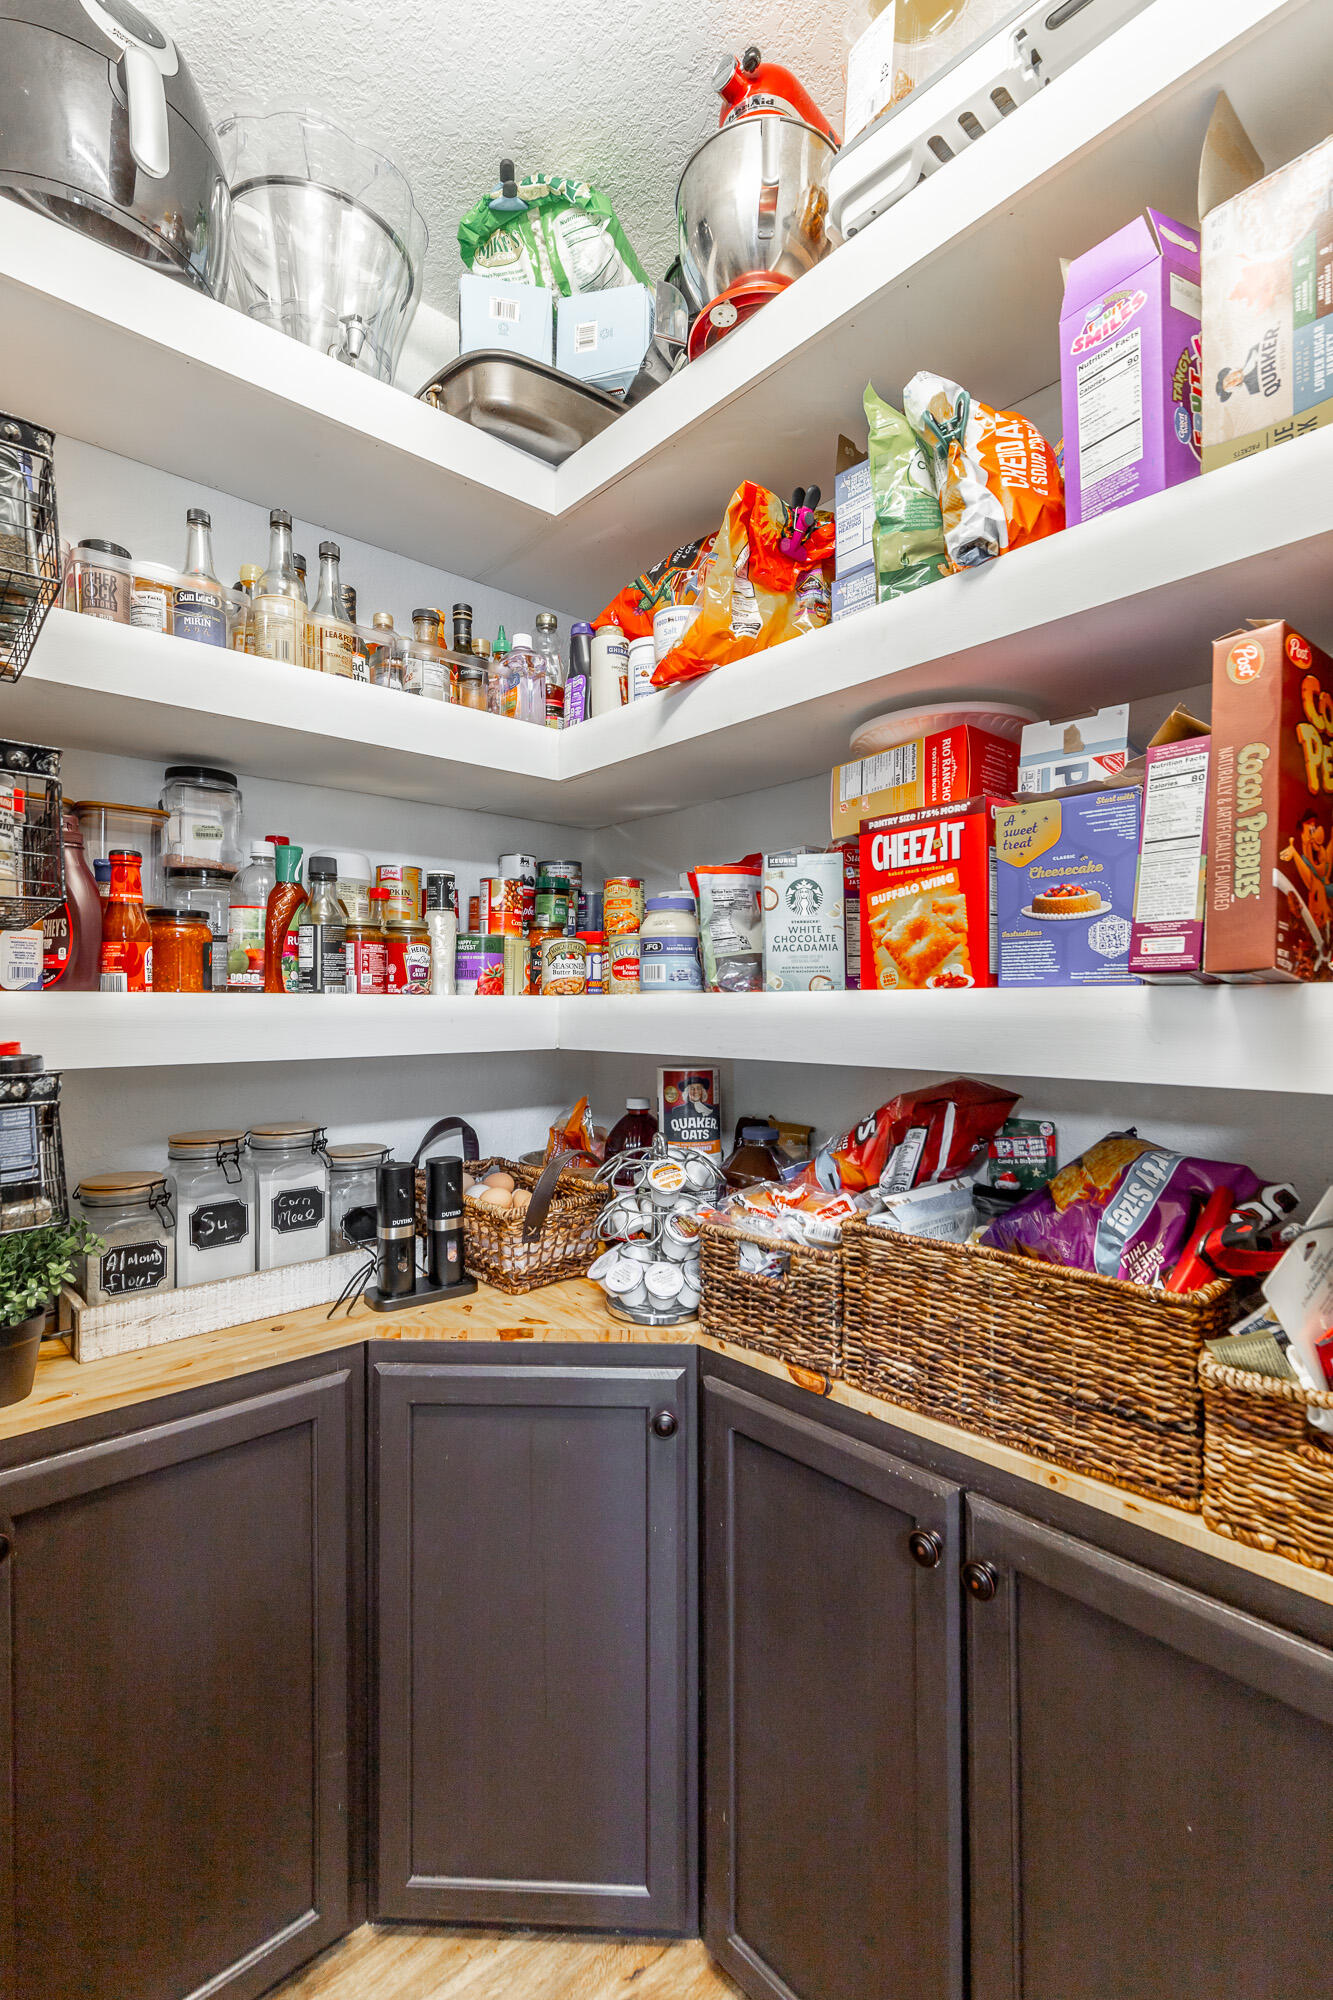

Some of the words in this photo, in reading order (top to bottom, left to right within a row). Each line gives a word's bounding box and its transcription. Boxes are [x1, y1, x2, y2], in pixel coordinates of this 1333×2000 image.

[560, 213, 586, 225] Nutrition
[1072, 292, 1146, 353] SMILES
[1313, 324, 1326, 357] SUGAR
[1078, 347, 1113, 372] Nutrition
[1115, 331, 1139, 349] Facts
[1262, 328, 1280, 397] QUAKER
[1079, 376, 1106, 395] Calories
[1127, 354, 1139, 367] 90
[1172, 348, 1192, 402] TANGY
[1313, 358, 1326, 393] LOWER
[1030, 452, 1048, 485] SOUR
[838, 520, 862, 535] HEATING
[179, 591, 195, 603] Sun
[195, 592, 216, 606] Luck
[183, 616, 211, 628] MIRIN
[663, 626, 677, 636] Salt
[325, 629, 338, 640] LEA
[608, 647, 629, 655] GHIRA
[1290, 638, 1309, 661] Post
[1233, 645, 1258, 677] Post
[941, 737, 952, 756] RIO
[1150, 759, 1183, 770] Nutrition
[1185, 755, 1206, 763] Facts
[1216, 747, 1233, 795] NATURALLY
[941, 758, 952, 802] RANCHO
[1149, 780, 1178, 790] Calories
[1191, 773, 1205, 782] 80
[1235, 742, 1271, 814] COCOA
[1095, 795, 1116, 805] Start
[1116, 792, 1135, 802] with
[1216, 797, 1230, 805] &
[868, 816, 899, 830] PANTRY
[898, 812, 916, 824] SIZE
[921, 808, 939, 819] 75%
[1003, 814, 1016, 827] A
[1003, 822, 1039, 838] sweet
[1215, 806, 1232, 862] ARTIFICIALLY
[1003, 836, 1032, 850] treat
[1233, 812, 1268, 900] PEBBLES
[920, 864, 944, 872] crackers
[1028, 861, 1104, 880] Cheesecake
[389, 888, 411, 896] PKIN
[871, 882, 920, 906] BUFFALO
[920, 872, 955, 891] WING
[1213, 865, 1230, 911] FLAVORED
[43, 918, 67, 938] SHEY'S
[787, 925, 823, 934] WHITE
[1001, 930, 1043, 938] Instructions
[644, 943, 659, 951] JFG
[771, 943, 839, 953] MACADAMIA
[773, 934, 837, 944] CHOCOLATE
[410, 945, 429, 954] HEINZ
[613, 943, 640, 959] LUCK
[586, 954, 601, 980] Ji
[670, 1116, 719, 1132] QUAKER
[681, 1129, 710, 1140] OATS
[993, 1136, 1048, 1157] PEZ
[1134, 1151, 1175, 1189] arty
[277, 1197, 311, 1208] Corn
[1105, 1182, 1153, 1237] Size!
[277, 1208, 315, 1226] Meal
[1119, 1240, 1148, 1268] CHILI
